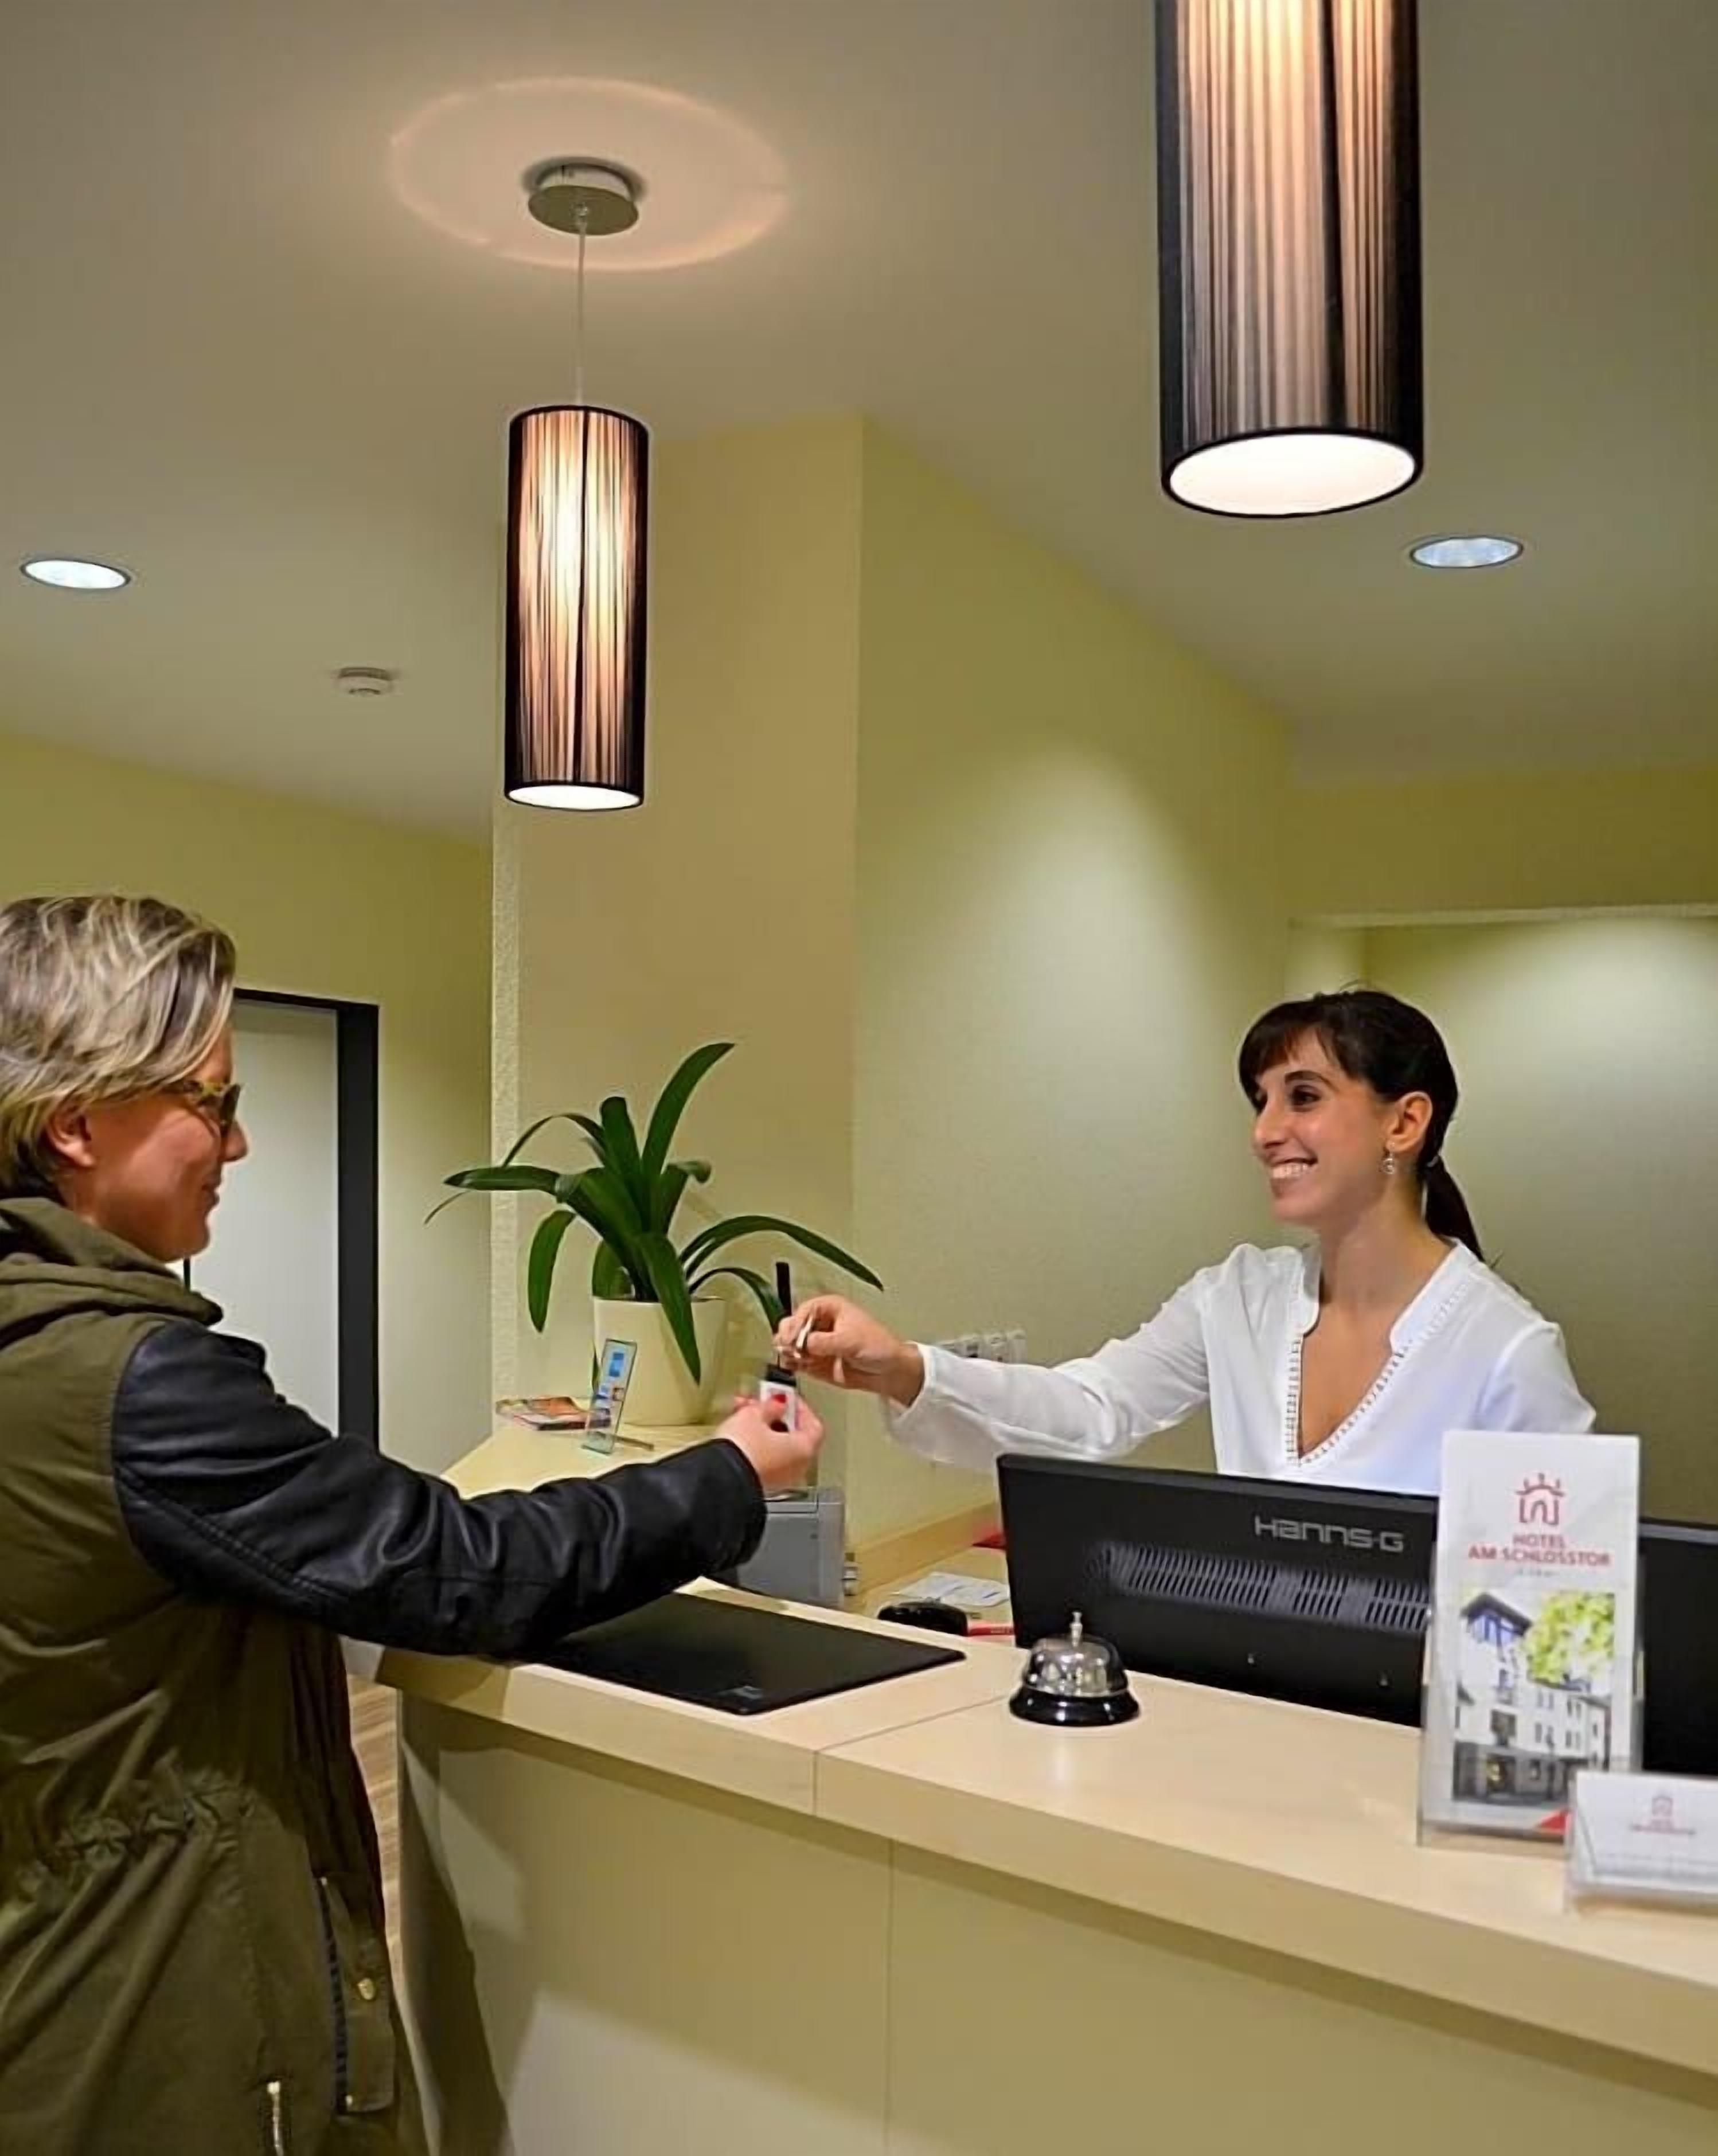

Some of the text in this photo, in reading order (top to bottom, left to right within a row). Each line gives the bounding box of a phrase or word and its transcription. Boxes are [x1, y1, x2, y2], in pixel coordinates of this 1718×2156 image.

[1512, 1534, 1565, 1549] HOTEL
[1468, 1545, 1611, 1567] AM SCHLOSSTOR
